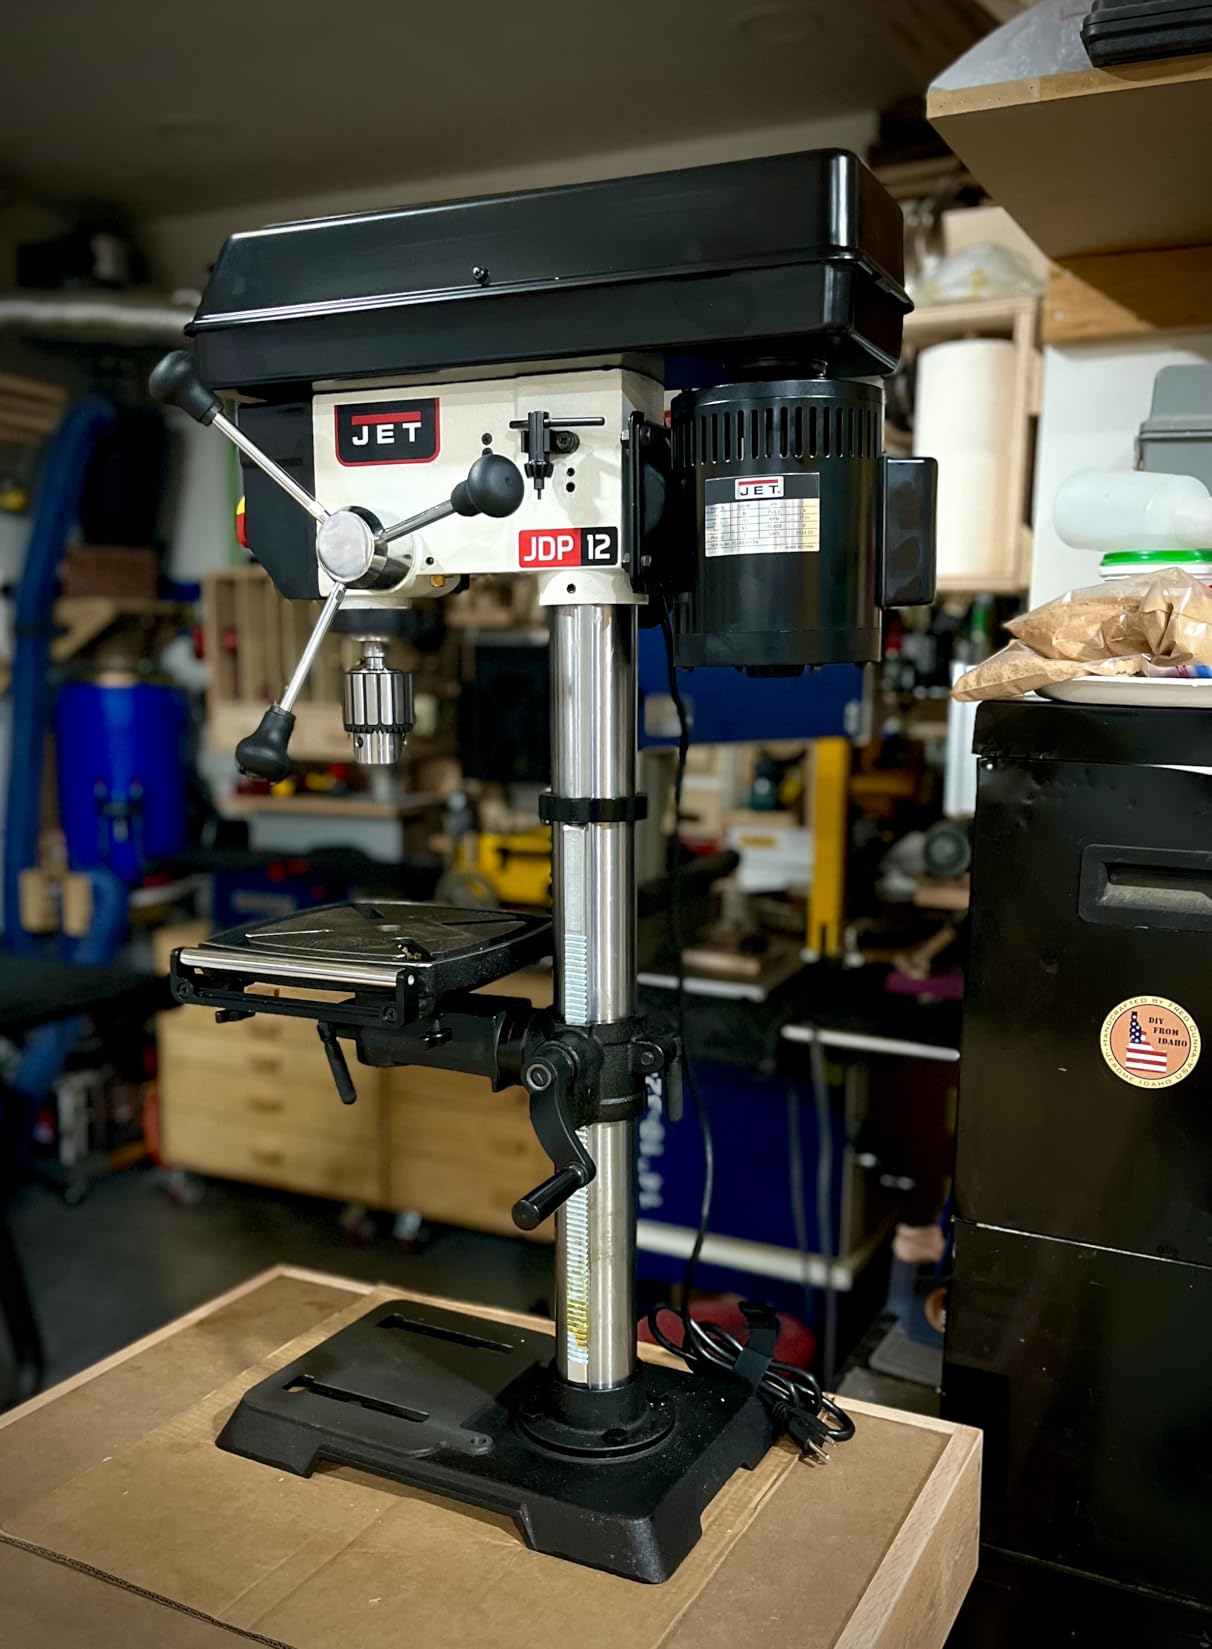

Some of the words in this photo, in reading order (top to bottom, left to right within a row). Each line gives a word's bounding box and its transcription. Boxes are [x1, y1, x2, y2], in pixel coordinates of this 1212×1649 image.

[351, 421, 422, 446] JET
[740, 485, 779, 496] JET
[523, 535, 574, 562] JDP
[586, 533, 611, 560] 12
[1103, 997, 1147, 1046] HANDCRAFTED
[1167, 1003, 1190, 1022] FRED
[1148, 1016, 1164, 1025] DIY
[1153, 1027, 1179, 1036] FROM
[1158, 1037, 1188, 1047] IDAHO
[1139, 1078, 1172, 1087] IDAHO
[1175, 1062, 1193, 1080] USA
